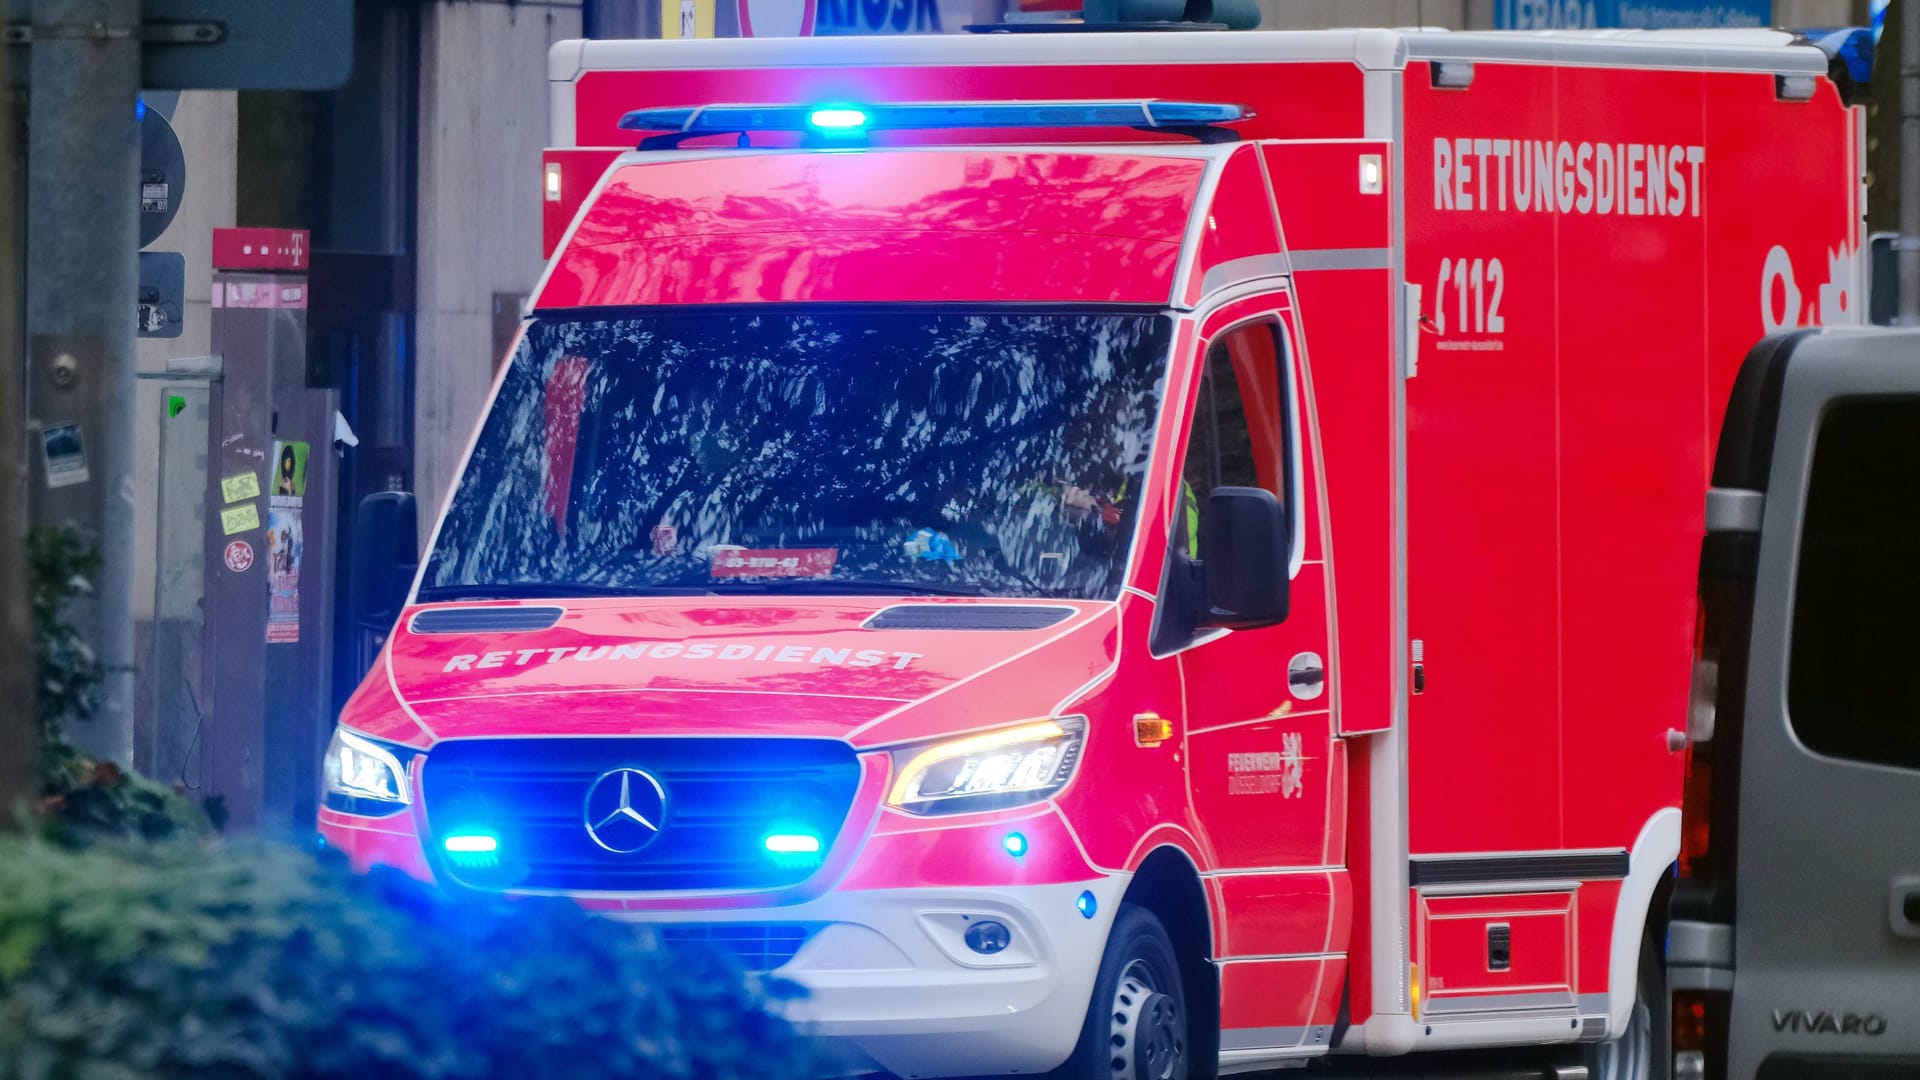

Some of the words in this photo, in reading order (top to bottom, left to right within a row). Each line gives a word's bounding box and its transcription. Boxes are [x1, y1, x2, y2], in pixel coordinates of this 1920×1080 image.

[1433, 137, 1705, 217] RETTUNGSDIENST
[1454, 257, 1504, 333] 112
[442, 643, 924, 673] RETTUNGSDIENST
[1770, 1009, 1888, 1036] VIVARO
